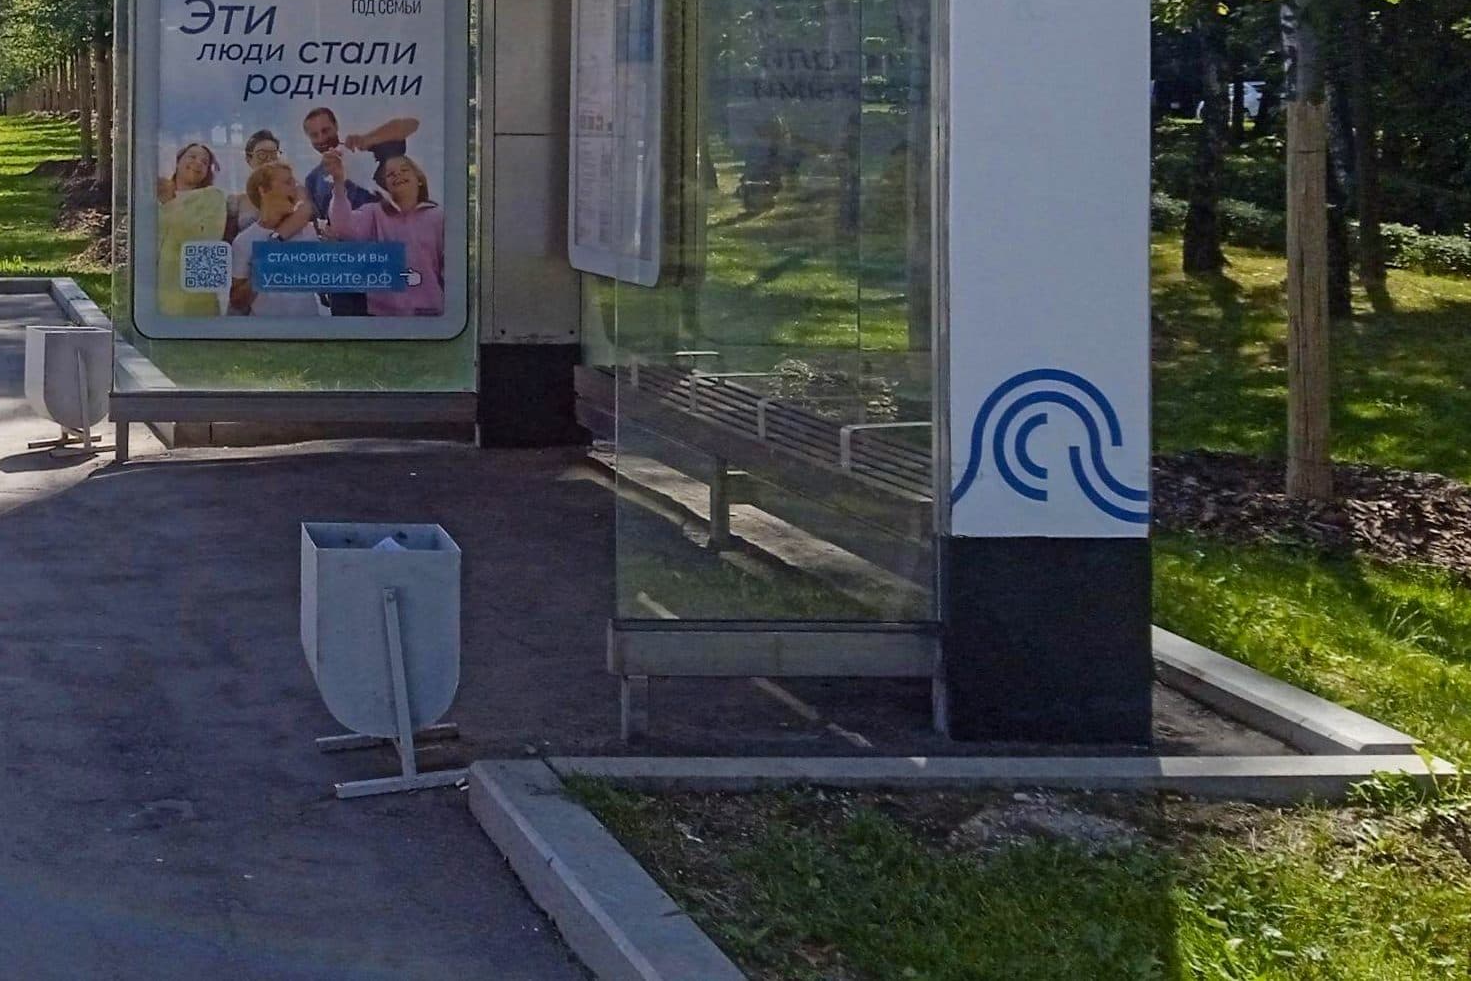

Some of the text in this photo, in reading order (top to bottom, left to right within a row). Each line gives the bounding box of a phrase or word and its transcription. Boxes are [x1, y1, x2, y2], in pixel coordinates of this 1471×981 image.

[351, 0, 376, 16] ГОД
[196, 40, 418, 65] люди стали
[242, 73, 423, 102] родными
[267, 252, 389, 263] СТАНОВИТЕСЬ И ВЫ
